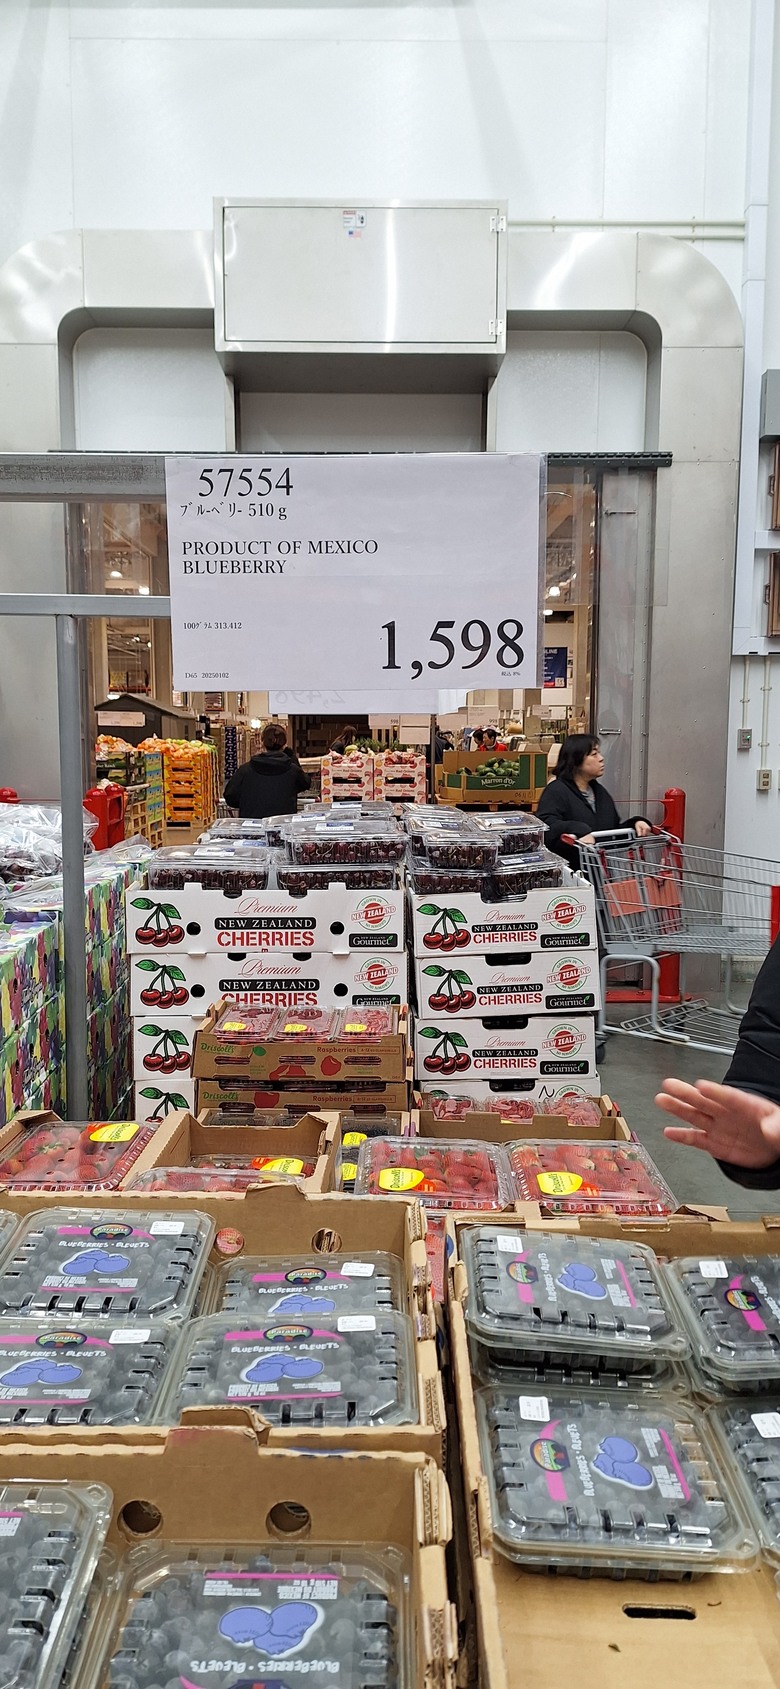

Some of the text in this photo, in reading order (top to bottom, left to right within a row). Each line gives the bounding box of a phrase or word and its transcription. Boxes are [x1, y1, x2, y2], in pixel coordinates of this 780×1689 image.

[198, 467, 294, 497] 57554
[248, 503, 275, 517] 510
[278, 507, 288, 521] g
[182, 540, 379, 555] PRODUCT OF MEXICO
[182, 560, 288, 574] BLUEBERRY
[214, 621, 243, 630] 313.412
[381, 618, 525, 680] 1,598
[481, 777, 503, 786] Marron
[234, 897, 298, 916] Premium
[541, 904, 586, 921] NEW ZEALAND
[351, 906, 396, 921] NEW ZEALAND
[484, 910, 526, 923] Premium
[218, 920, 313, 928] NEW ZEALAND
[217, 931, 315, 946] CHERRIES
[352, 937, 390, 946] Gourmet
[473, 931, 537, 944] CHERRIES
[544, 937, 582, 946] Gourmet
[238, 959, 302, 978] Premium
[354, 967, 398, 982] NEW ZEALAND
[546, 966, 592, 984] NEW ZEALAND
[489, 972, 530, 984] Premium
[222, 981, 316, 990] NEW ZEALAND
[500, 984, 541, 992] ZEALAND
[478, 992, 542, 1006] CHERRIES
[550, 998, 587, 1007] Gourmet
[200, 1042, 234, 1053] Driscoll's
[484, 1036, 526, 1048] Premium
[542, 1034, 586, 1049] NEW ZEALAND
[474, 1058, 537, 1068] CHERRIES
[544, 1064, 580, 1072] Gourmet
[202, 1092, 238, 1100] Driscoll's
[58, 1240, 108, 1248] BLUEBERRIES
[299, 1342, 340, 1350] BLEUETS
[190, 1660, 340, 1673] BLUEBERRIES BLEUETS
